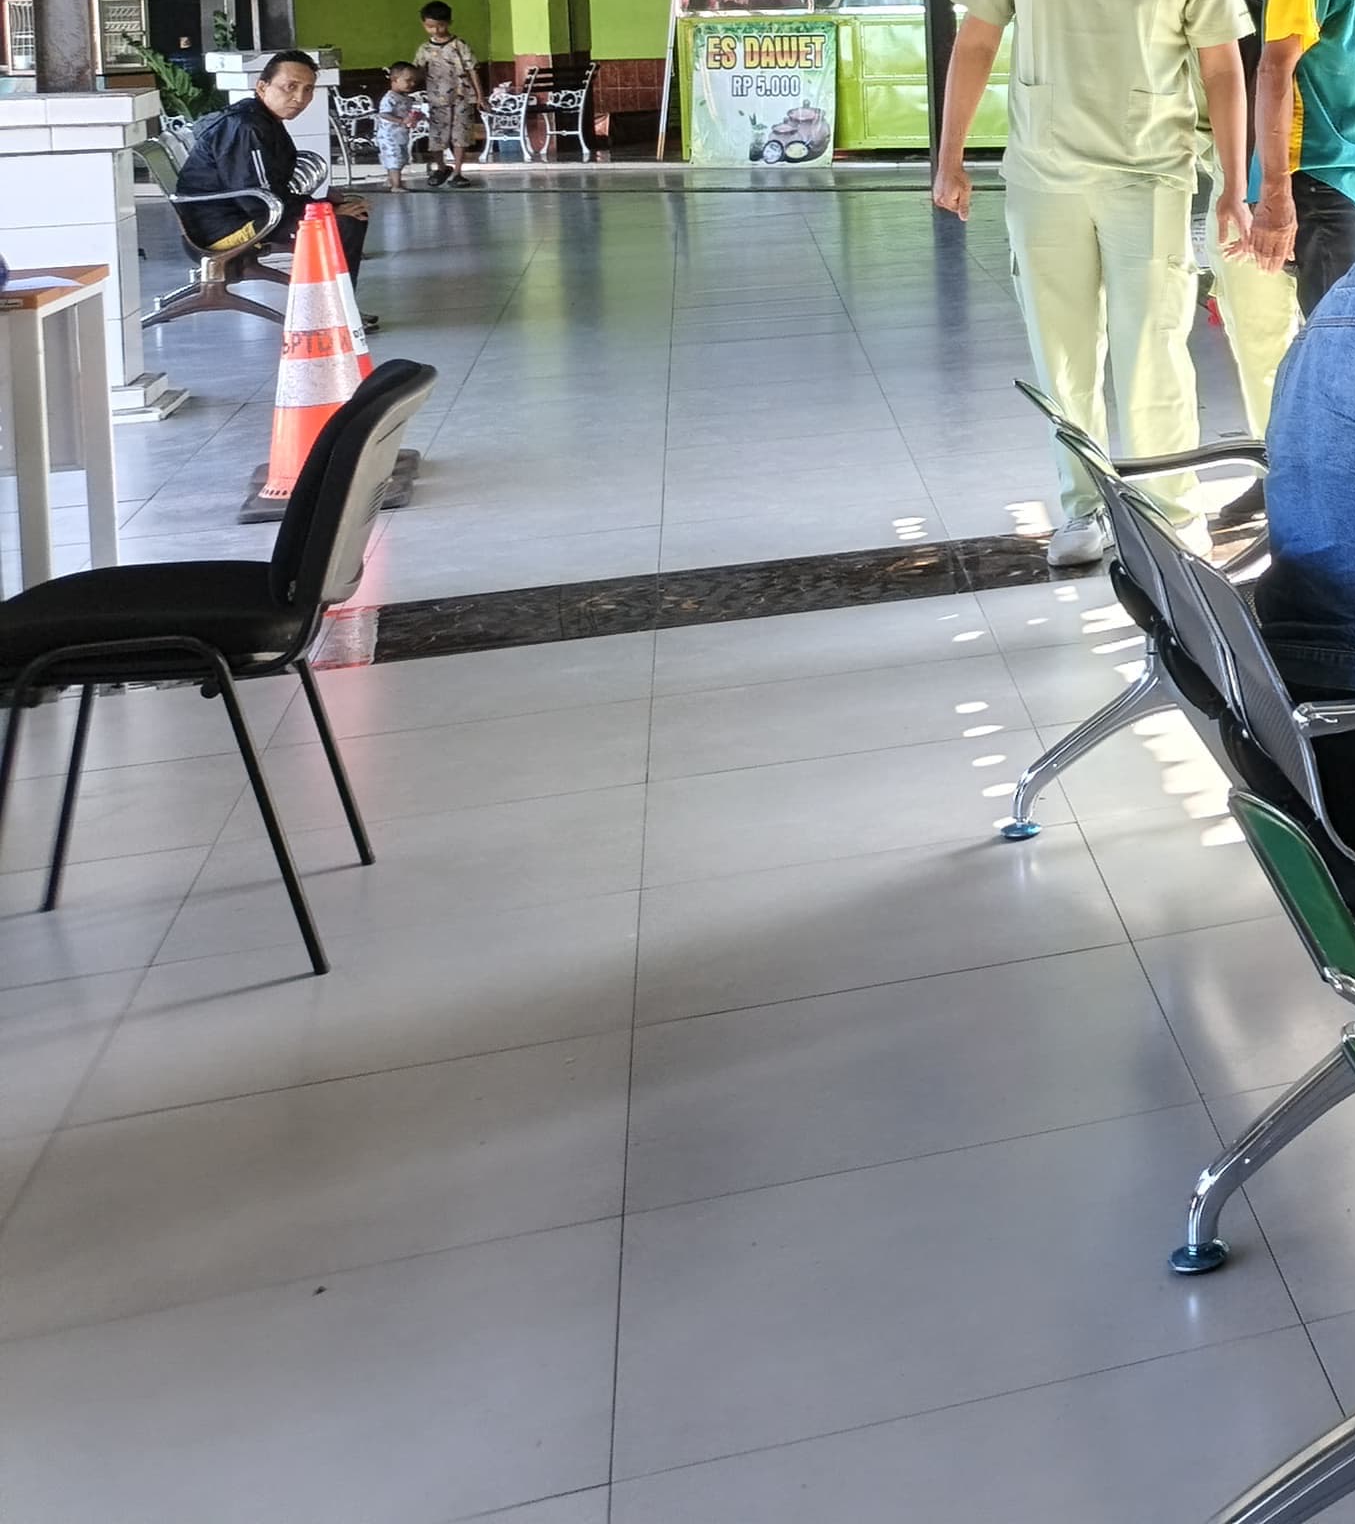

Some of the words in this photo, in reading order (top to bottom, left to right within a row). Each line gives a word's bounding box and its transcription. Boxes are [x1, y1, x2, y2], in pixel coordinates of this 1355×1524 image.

[706, 35, 737, 70] ES
[744, 33, 827, 69] DAWET
[732, 76, 753, 98] RP
[756, 75, 801, 98] 5.000
